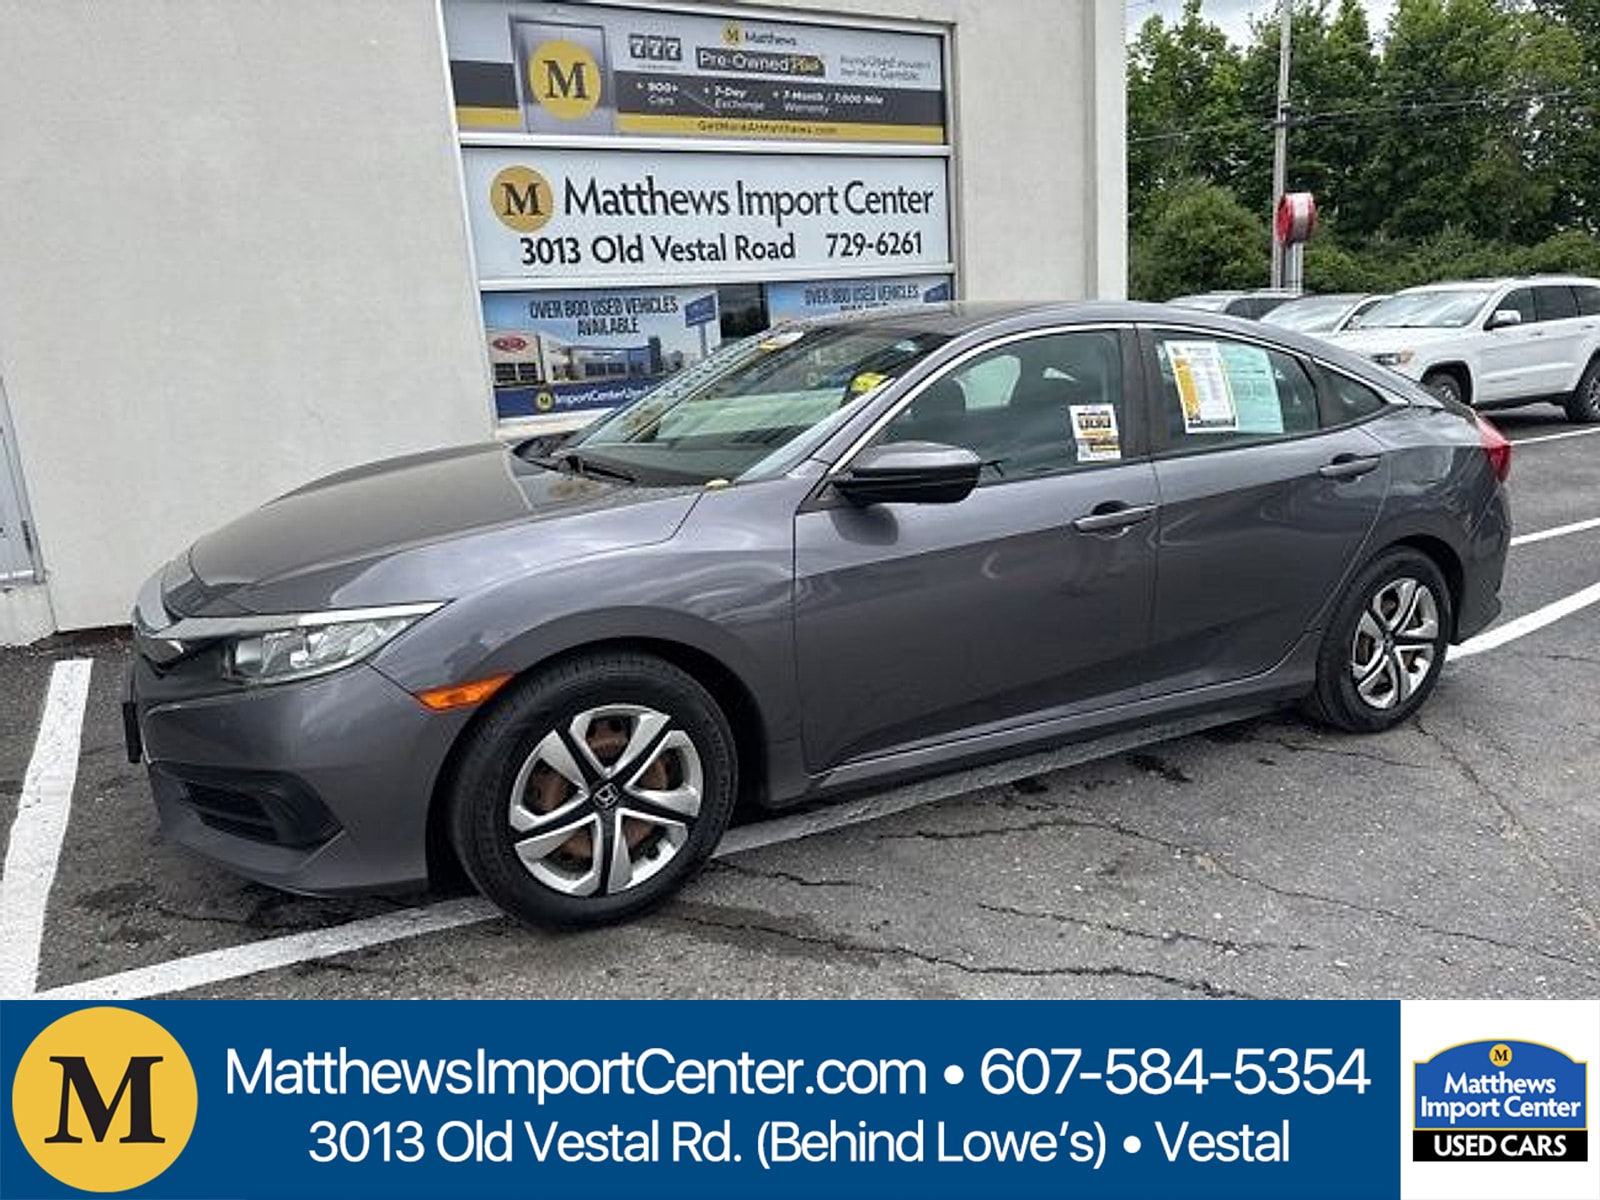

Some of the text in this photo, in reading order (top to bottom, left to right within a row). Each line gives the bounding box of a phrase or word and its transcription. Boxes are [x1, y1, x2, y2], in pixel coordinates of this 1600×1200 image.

[543, 60, 590, 99] M
[500, 175, 934, 228] M Matthews Import Center
[520, 230, 922, 265] 3013 Old Vestal Road 729-6261
[530, 299, 563, 319] OVER
[591, 297, 624, 317] USED
[625, 295, 679, 316] VEHICLES
[577, 318, 641, 337] AVAILABLE
